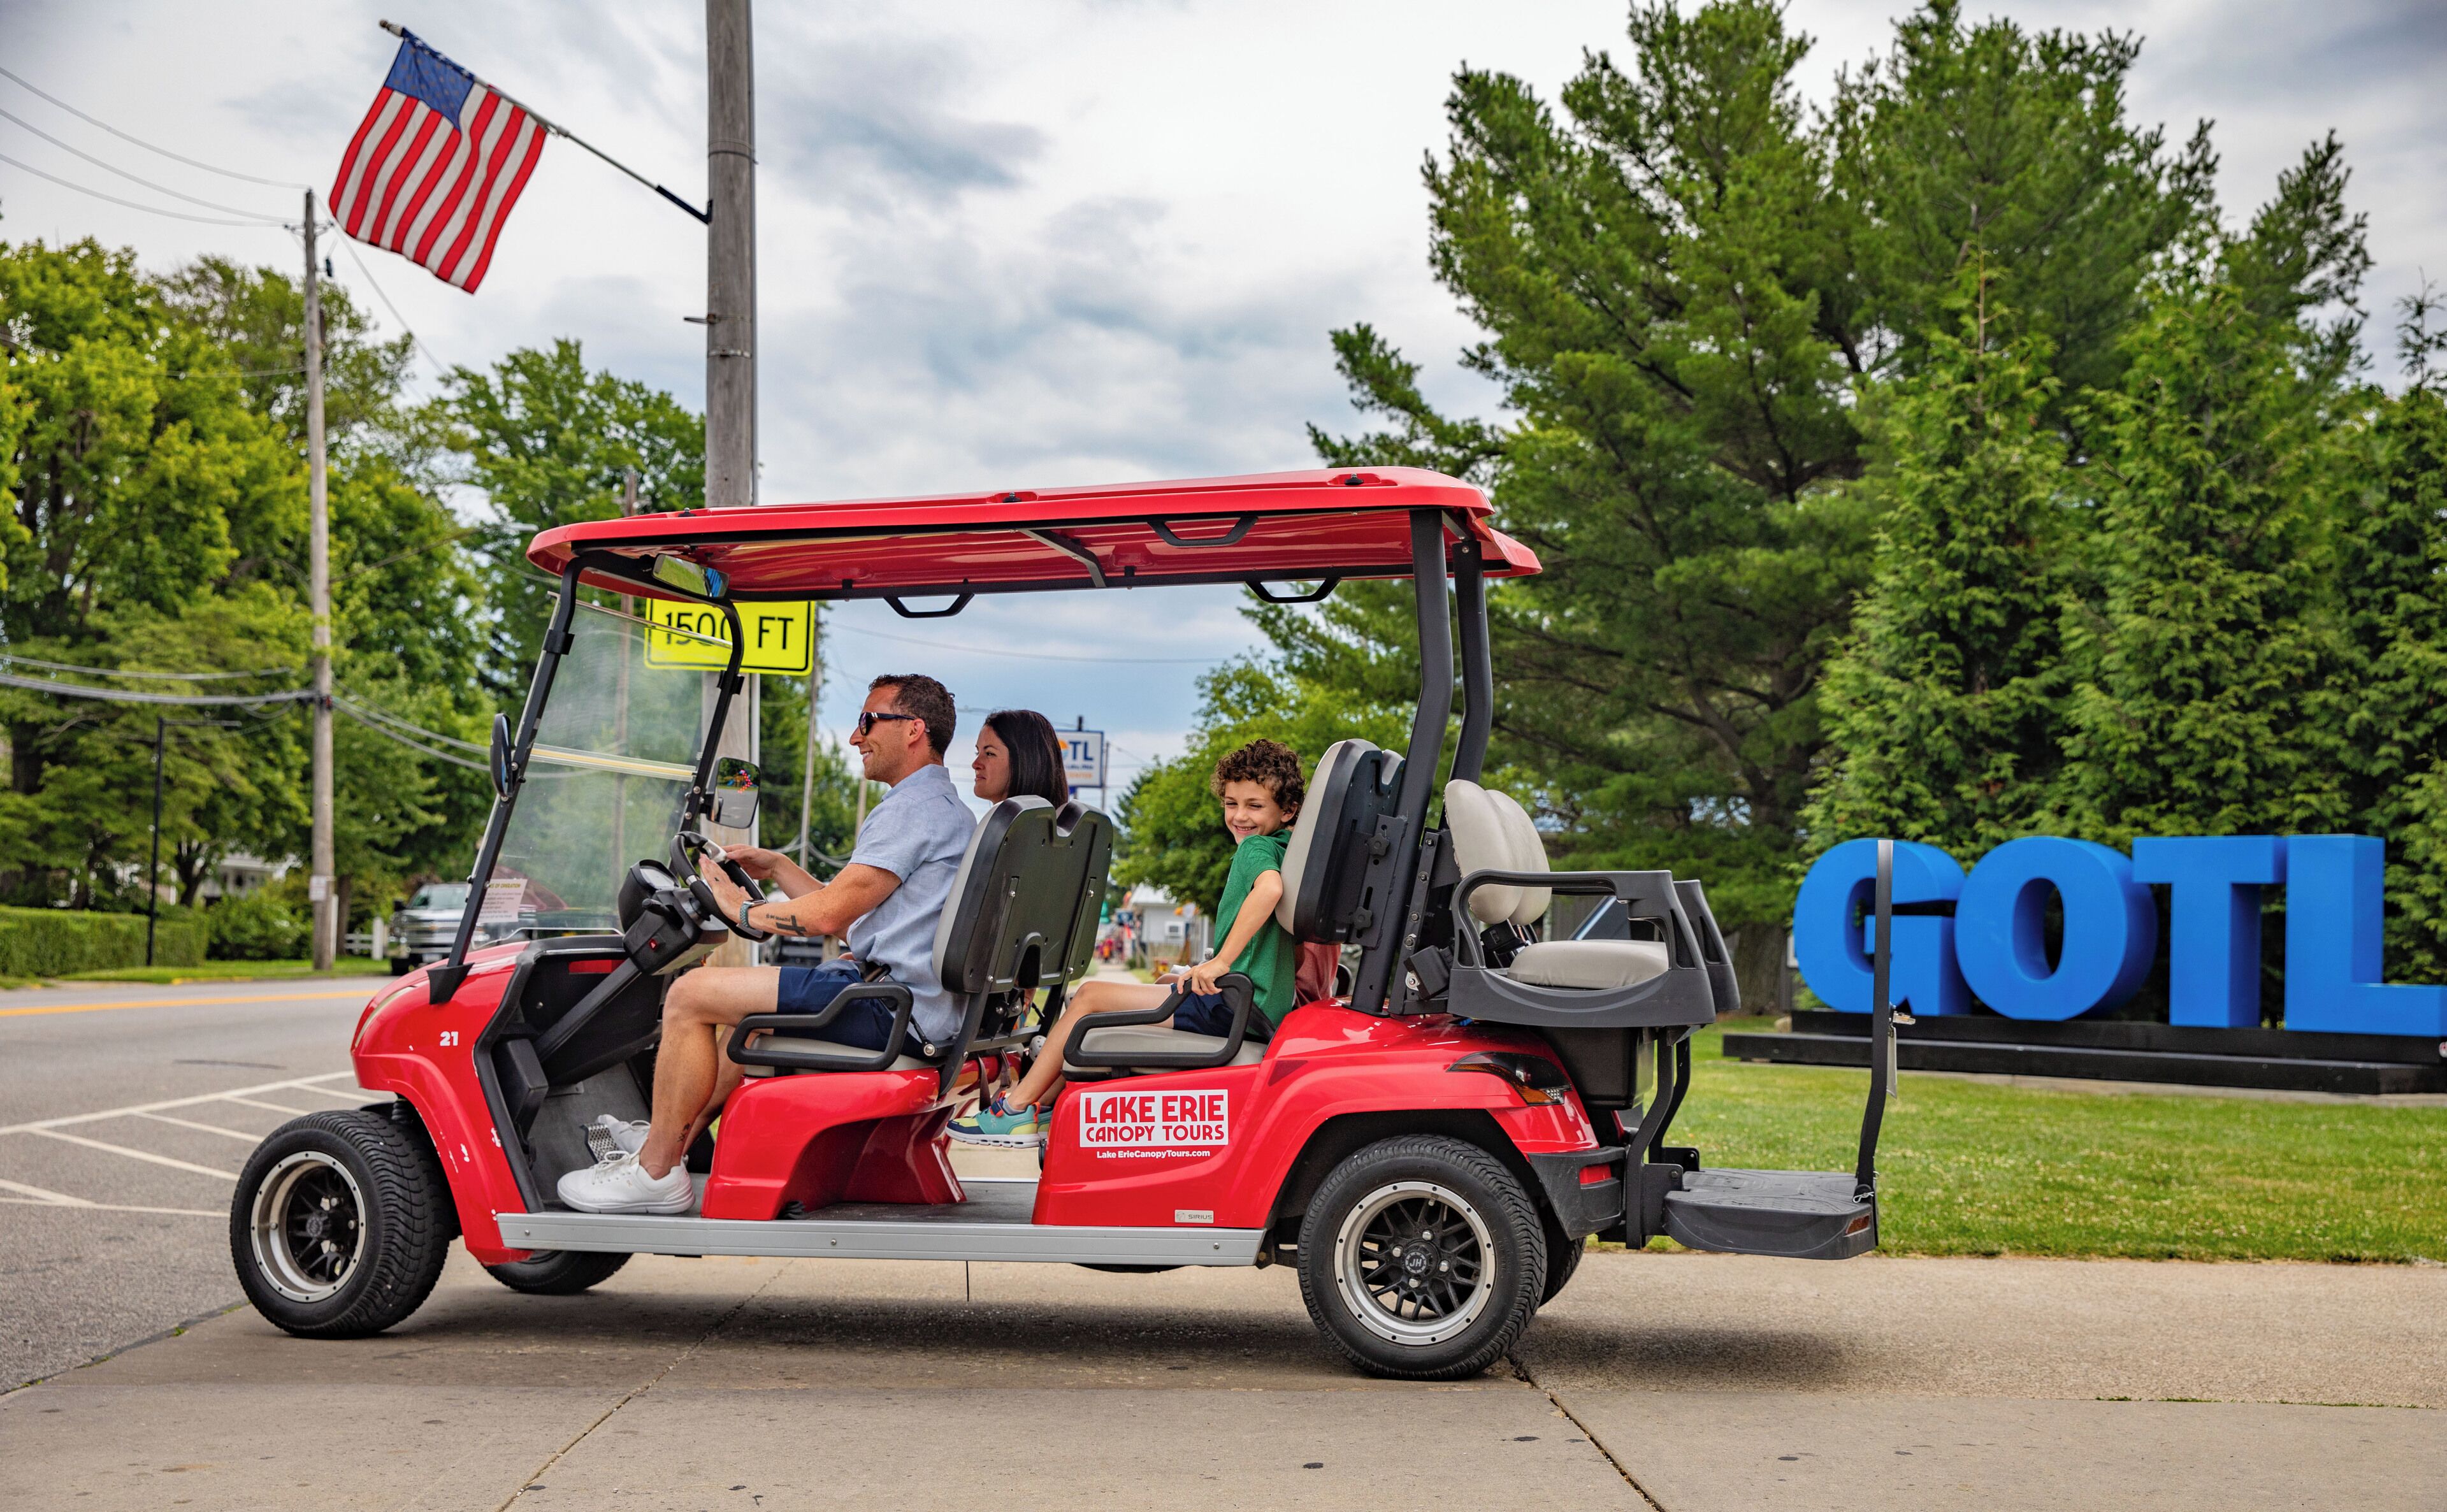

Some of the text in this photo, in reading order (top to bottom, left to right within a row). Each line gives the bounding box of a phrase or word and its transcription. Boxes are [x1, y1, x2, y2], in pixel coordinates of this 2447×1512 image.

[758, 616, 794, 650] FT
[1793, 834, 2447, 1037] GOTL
[439, 1031, 459, 1047] 21
[1085, 1095, 1224, 1124] LAKE ERIE
[1086, 1125, 1225, 1142] CANOPY TOURS
[1118, 1149, 1210, 1159] ErieCanopyTours.com
[1409, 1258, 1422, 1267] JH
